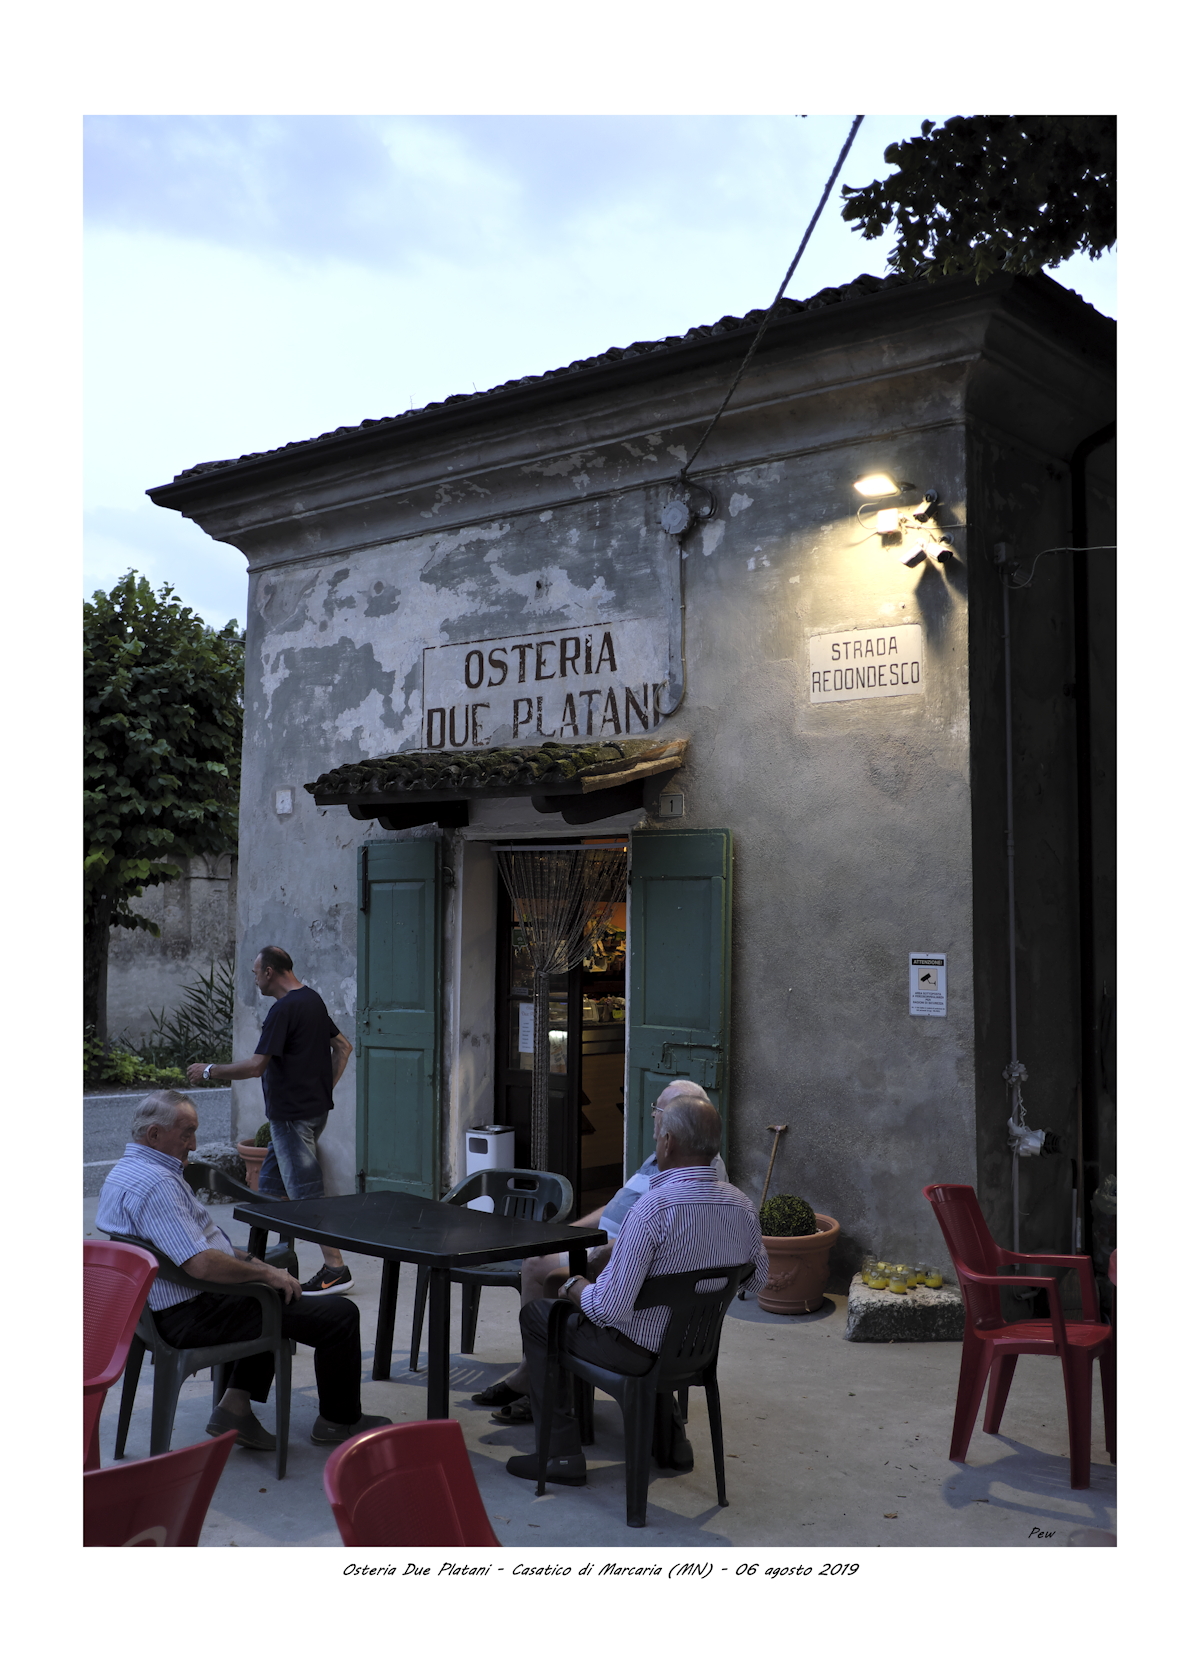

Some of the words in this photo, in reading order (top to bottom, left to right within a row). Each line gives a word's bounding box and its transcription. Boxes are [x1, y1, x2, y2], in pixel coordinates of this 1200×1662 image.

[464, 631, 617, 689] OSTERIA
[831, 636, 898, 661] STRADA
[812, 661, 920, 693] REDONDESCO
[427, 702, 490, 748] DUE
[512, 682, 662, 739] PLATANI
[669, 799, 674, 813] 1
